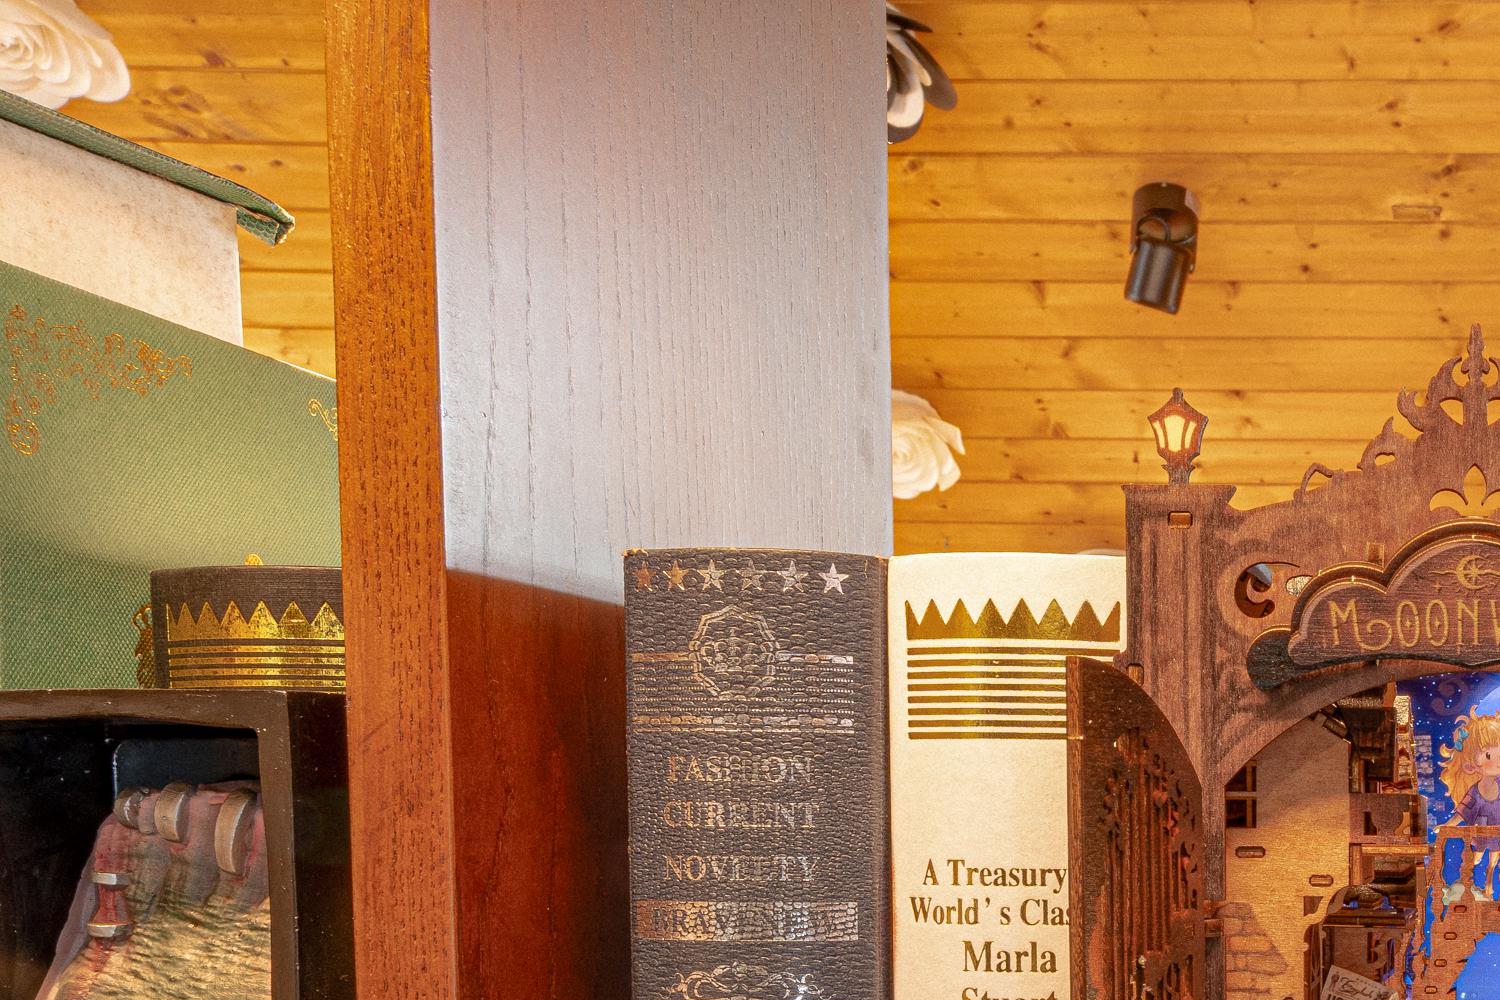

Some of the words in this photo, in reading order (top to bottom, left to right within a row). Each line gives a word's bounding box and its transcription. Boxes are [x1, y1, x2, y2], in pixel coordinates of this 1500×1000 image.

[667, 754, 812, 784] FASHION
[663, 801, 820, 829] CURRENT
[664, 854, 820, 882] NOVELTY
[923, 858, 939, 886] A
[947, 859, 1068, 894] Treasury
[963, 940, 1058, 973] Marla
